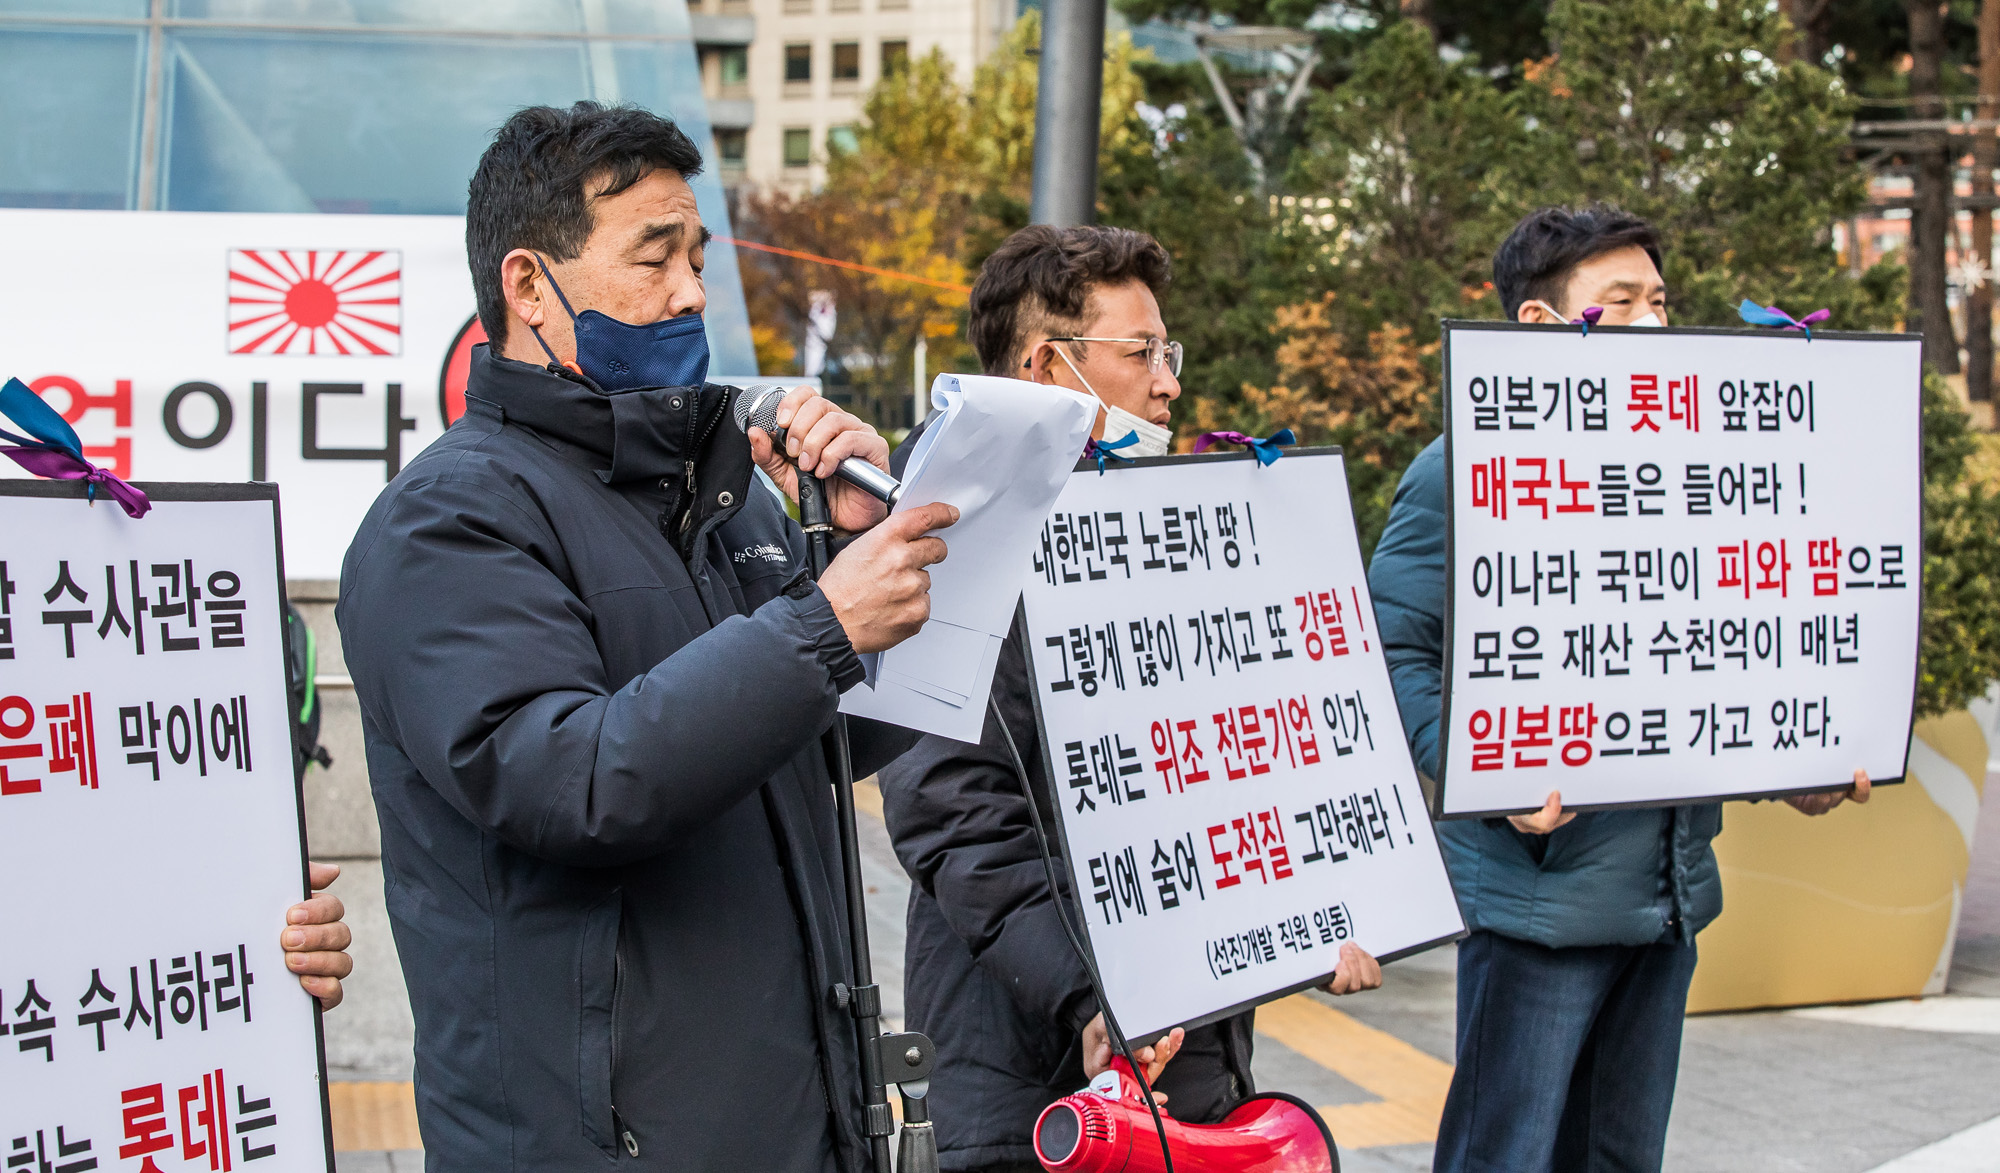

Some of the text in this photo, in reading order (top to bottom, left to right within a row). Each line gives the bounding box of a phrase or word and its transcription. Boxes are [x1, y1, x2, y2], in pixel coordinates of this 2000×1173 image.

[1469, 374, 1815, 434] 일본기업 롯데 앞잡이
[1471, 455, 1666, 521] 매국노들은
[1682, 462, 1782, 516] 들어라
[1138, 504, 1211, 573] 노른자
[1215, 502, 1241, 569] 땅
[1472, 536, 1907, 608] 이나라 국민이 피와 땀으로
[41, 558, 247, 659] 수사관을
[1045, 620, 1126, 698] 그렇게
[1128, 613, 1184, 688] 많이
[1187, 606, 1262, 677] 가지고
[1264, 604, 1294, 661] 또
[1294, 588, 1350, 662] 강탈
[1468, 613, 1859, 681] 모은 재산 수천억이 매년
[0, 691, 253, 796] 은폐 막이에
[1064, 689, 1375, 815] 롯데는 위조 전문기업 인가
[1468, 696, 1840, 772] 일본땅으로 가고 있다.
[1087, 845, 1148, 925] 뒤에
[1150, 831, 1205, 911] 숨어
[1206, 806, 1294, 890] 도적질
[1294, 787, 1395, 864] 그만해라
[1206, 902, 1354, 981] (선진개발 직원 일동)
[0, 943, 254, 1063] 속 수사하라
[118, 1068, 277, 1173] 롯데는
